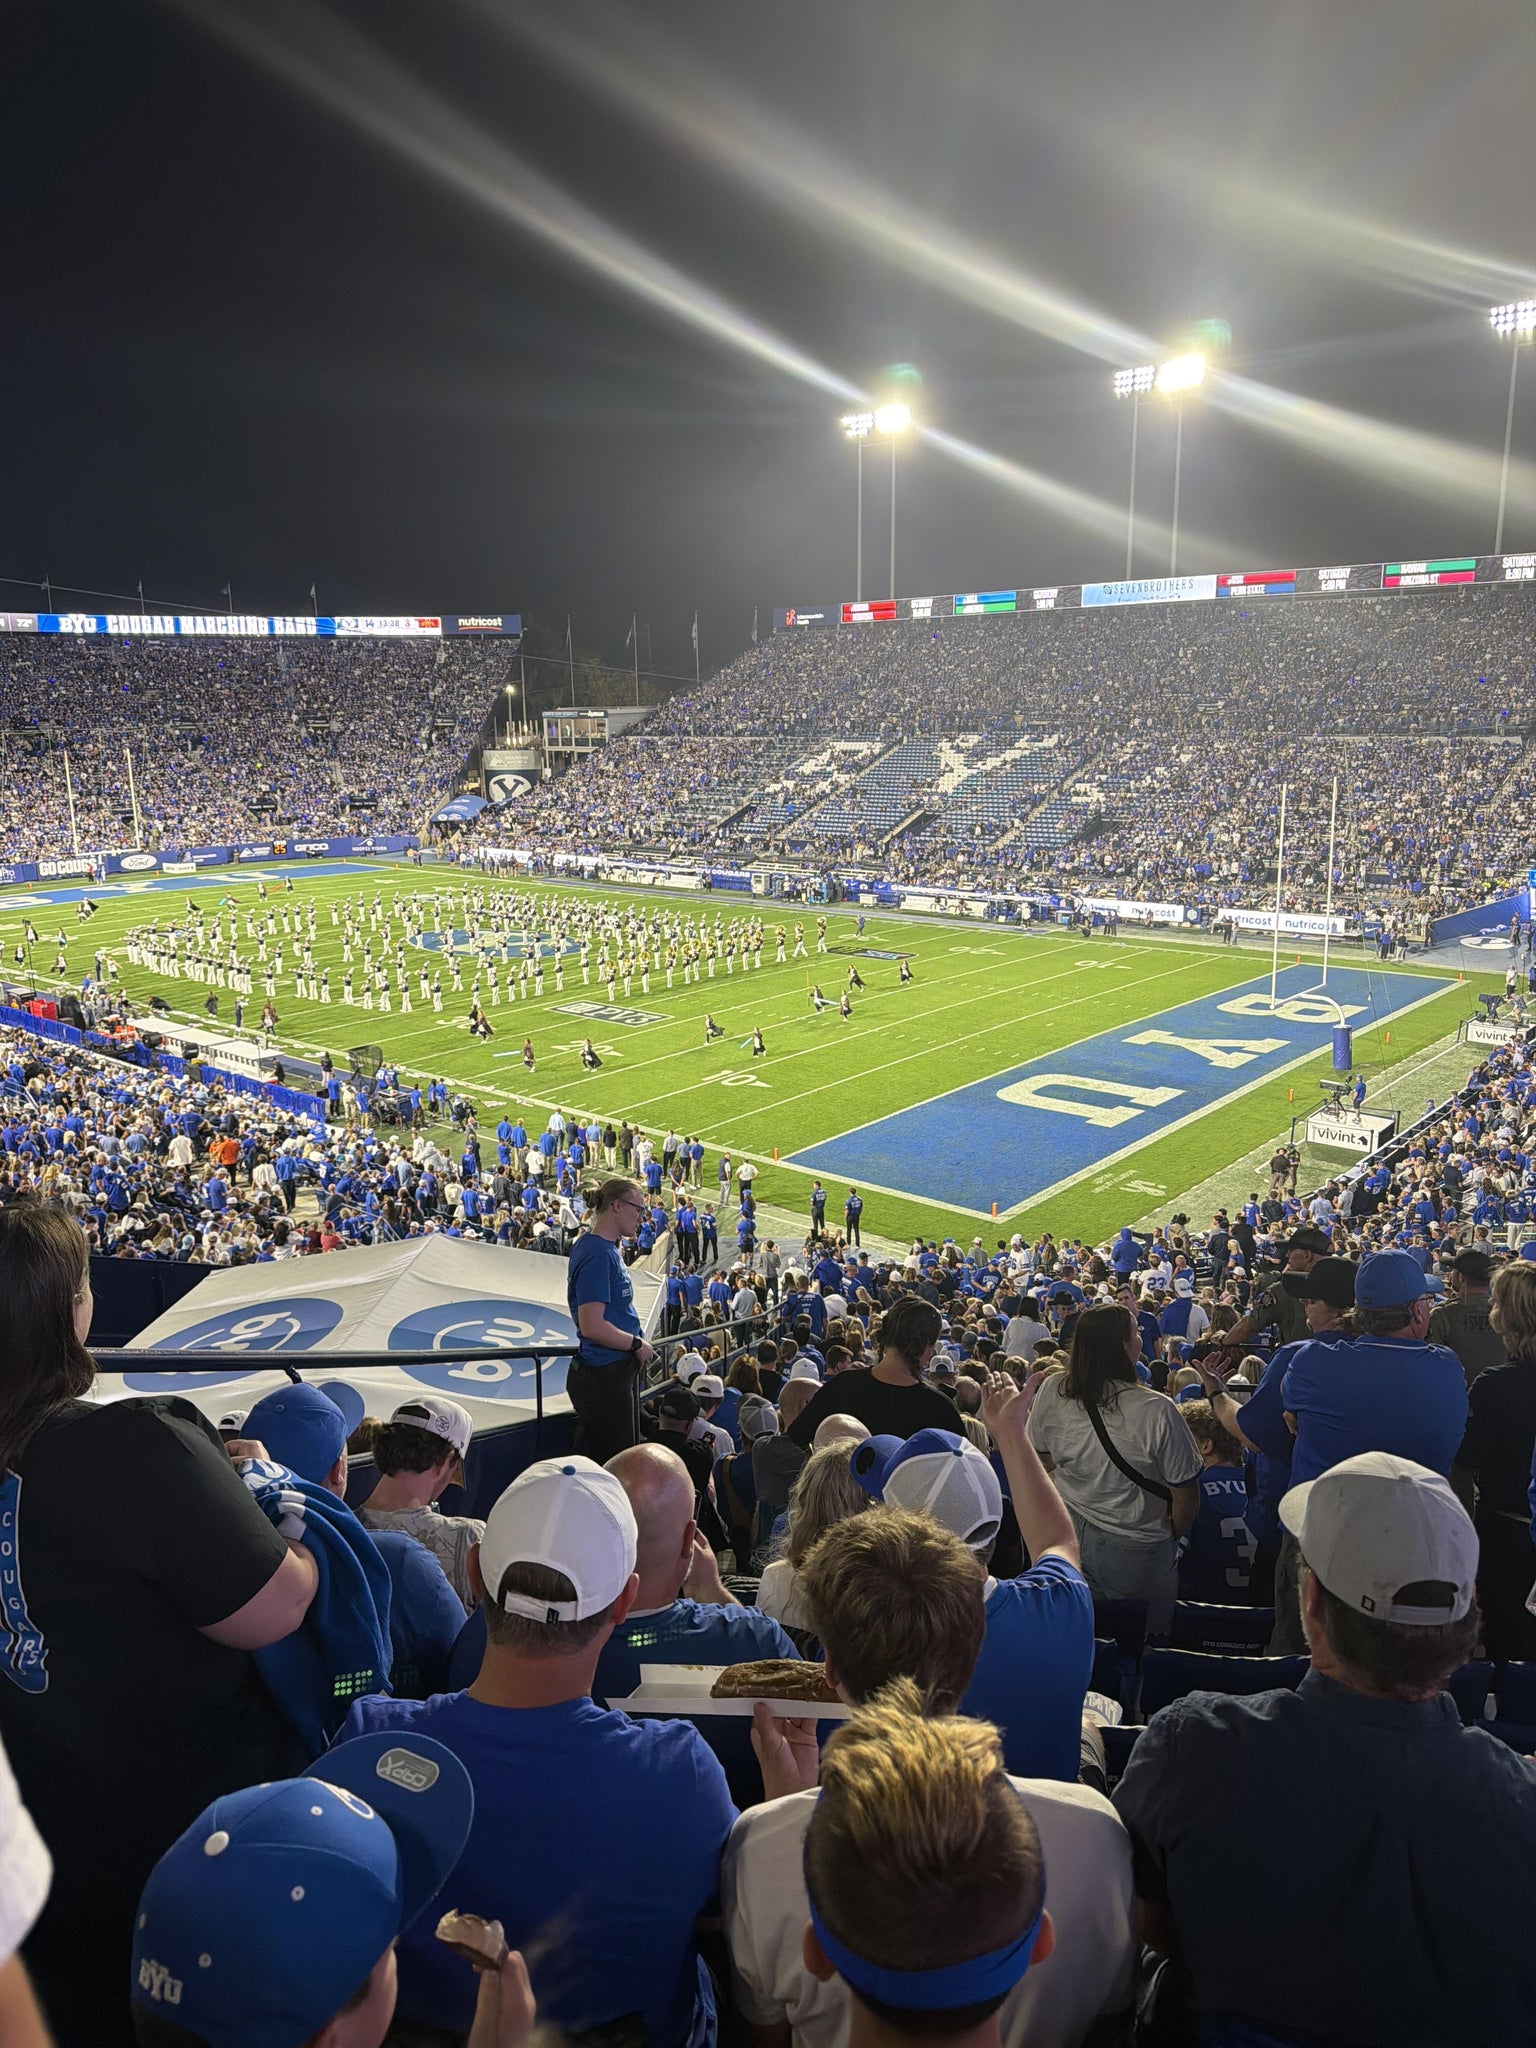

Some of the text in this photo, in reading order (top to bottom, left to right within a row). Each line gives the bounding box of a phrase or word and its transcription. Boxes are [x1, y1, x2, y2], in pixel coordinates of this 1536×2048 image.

[1502, 555, 1536, 568] SATURDA
[58, 613, 316, 634] BYU COUGAR MARCHING BAND
[458, 616, 502, 626] nutricost
[39, 858, 97, 876] GO COUGS
[128, 858, 149, 867] Ford
[711, 868, 750, 878] COUGARS
[1132, 906, 1176, 918] nutcost
[1236, 915, 1272, 926] tricost
[1285, 919, 1330, 931] nutrico
[1475, 1029, 1508, 1041] vivint
[701, 1069, 758, 1086] 10
[1317, 1127, 1357, 1145] vivint
[1147, 1277, 1167, 1290] 23
[1203, 1480, 1247, 1497] BYU
[1, 1510, 41, 1666] COUGARS
[137, 1957, 184, 2005] BYU
